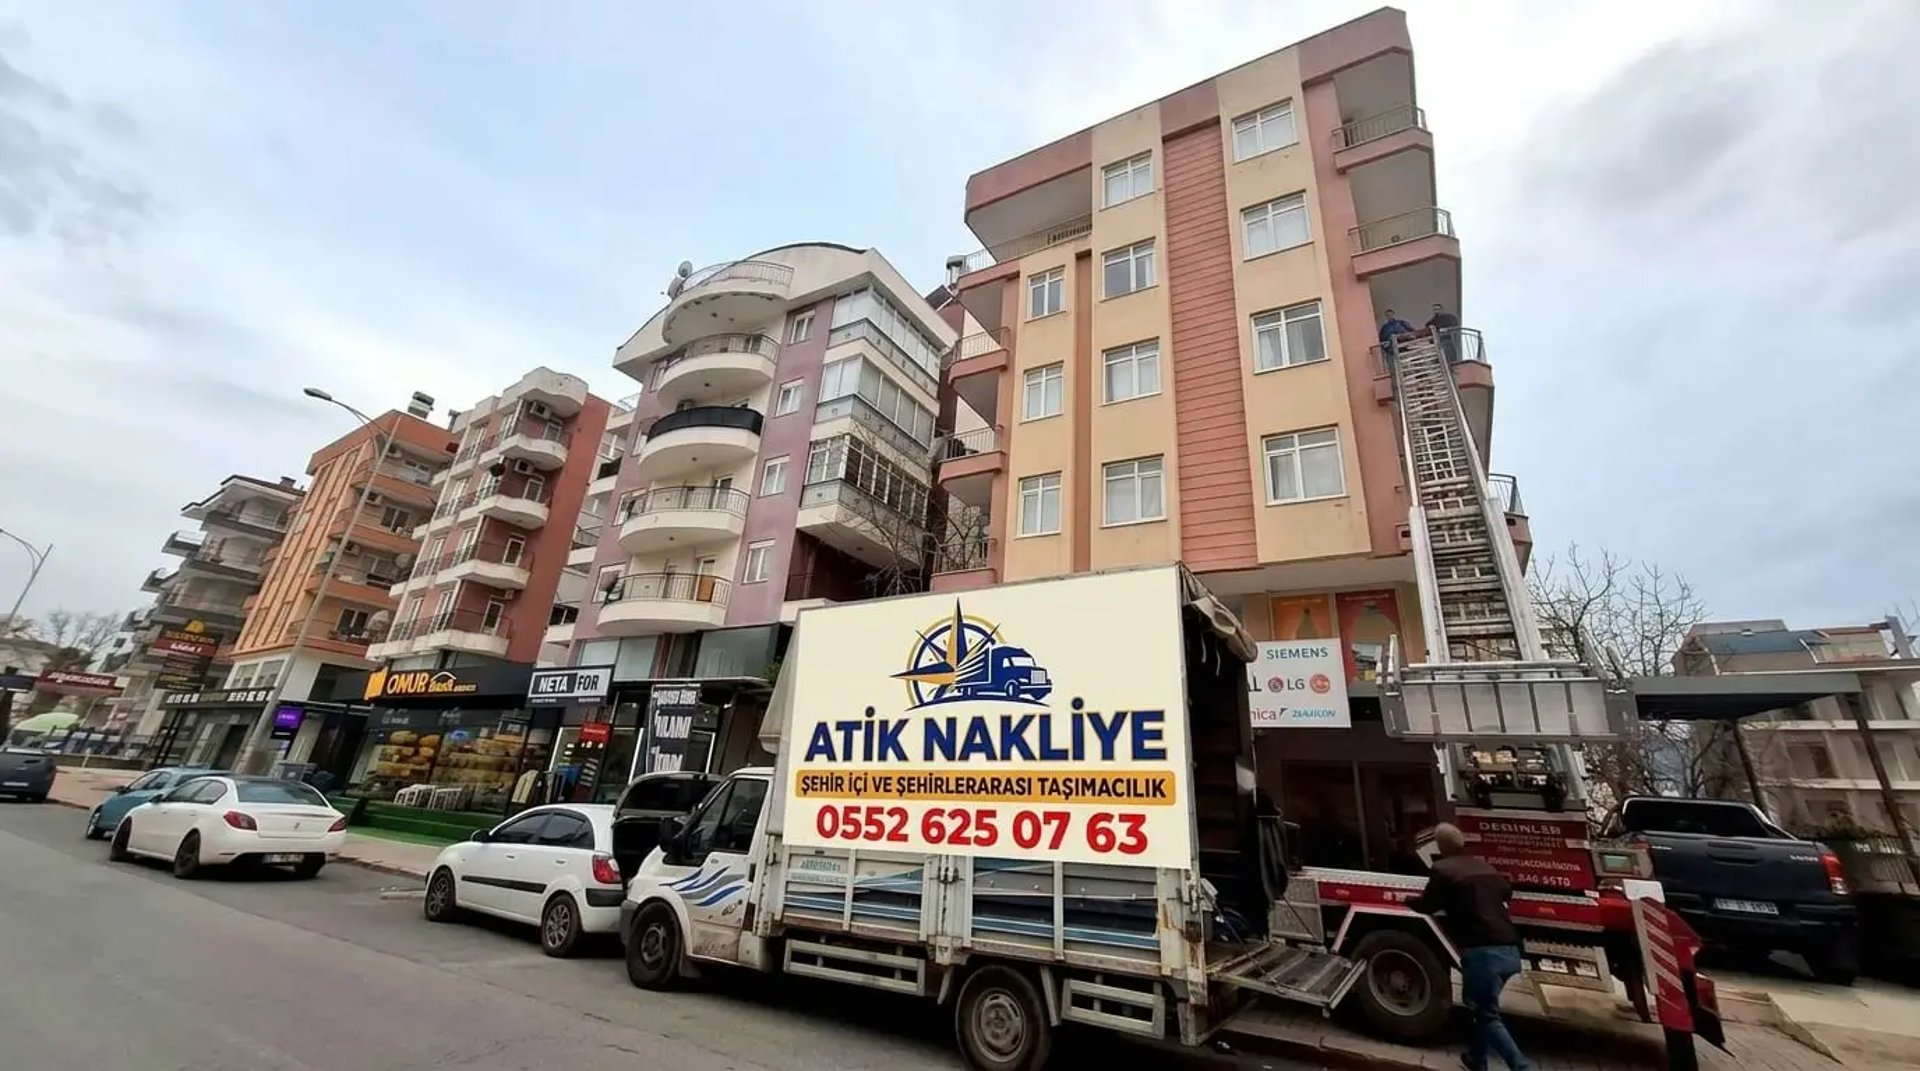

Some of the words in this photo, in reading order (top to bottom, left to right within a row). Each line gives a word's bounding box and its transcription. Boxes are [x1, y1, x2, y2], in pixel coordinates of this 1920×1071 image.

[1266, 647, 1328, 660] SIEMENS
[386, 672, 429, 695] ONUR
[538, 676, 568, 693] NETA
[577, 675, 599, 691] FOR
[1287, 678, 1306, 691] LG
[804, 706, 910, 762] ATİK
[923, 697, 1167, 762] NAKLİYE
[801, 774, 844, 793] ŞEHİR
[848, 774, 868, 794] İÇİ
[873, 778, 892, 792] VE
[896, 773, 1032, 797] ŞEHİRLERARASI
[1039, 778, 1166, 800] TAŞIMACILIK
[816, 804, 909, 842] 0552
[920, 807, 999, 847] 625
[1012, 810, 1071, 850] 07
[1086, 812, 1149, 855] 63
